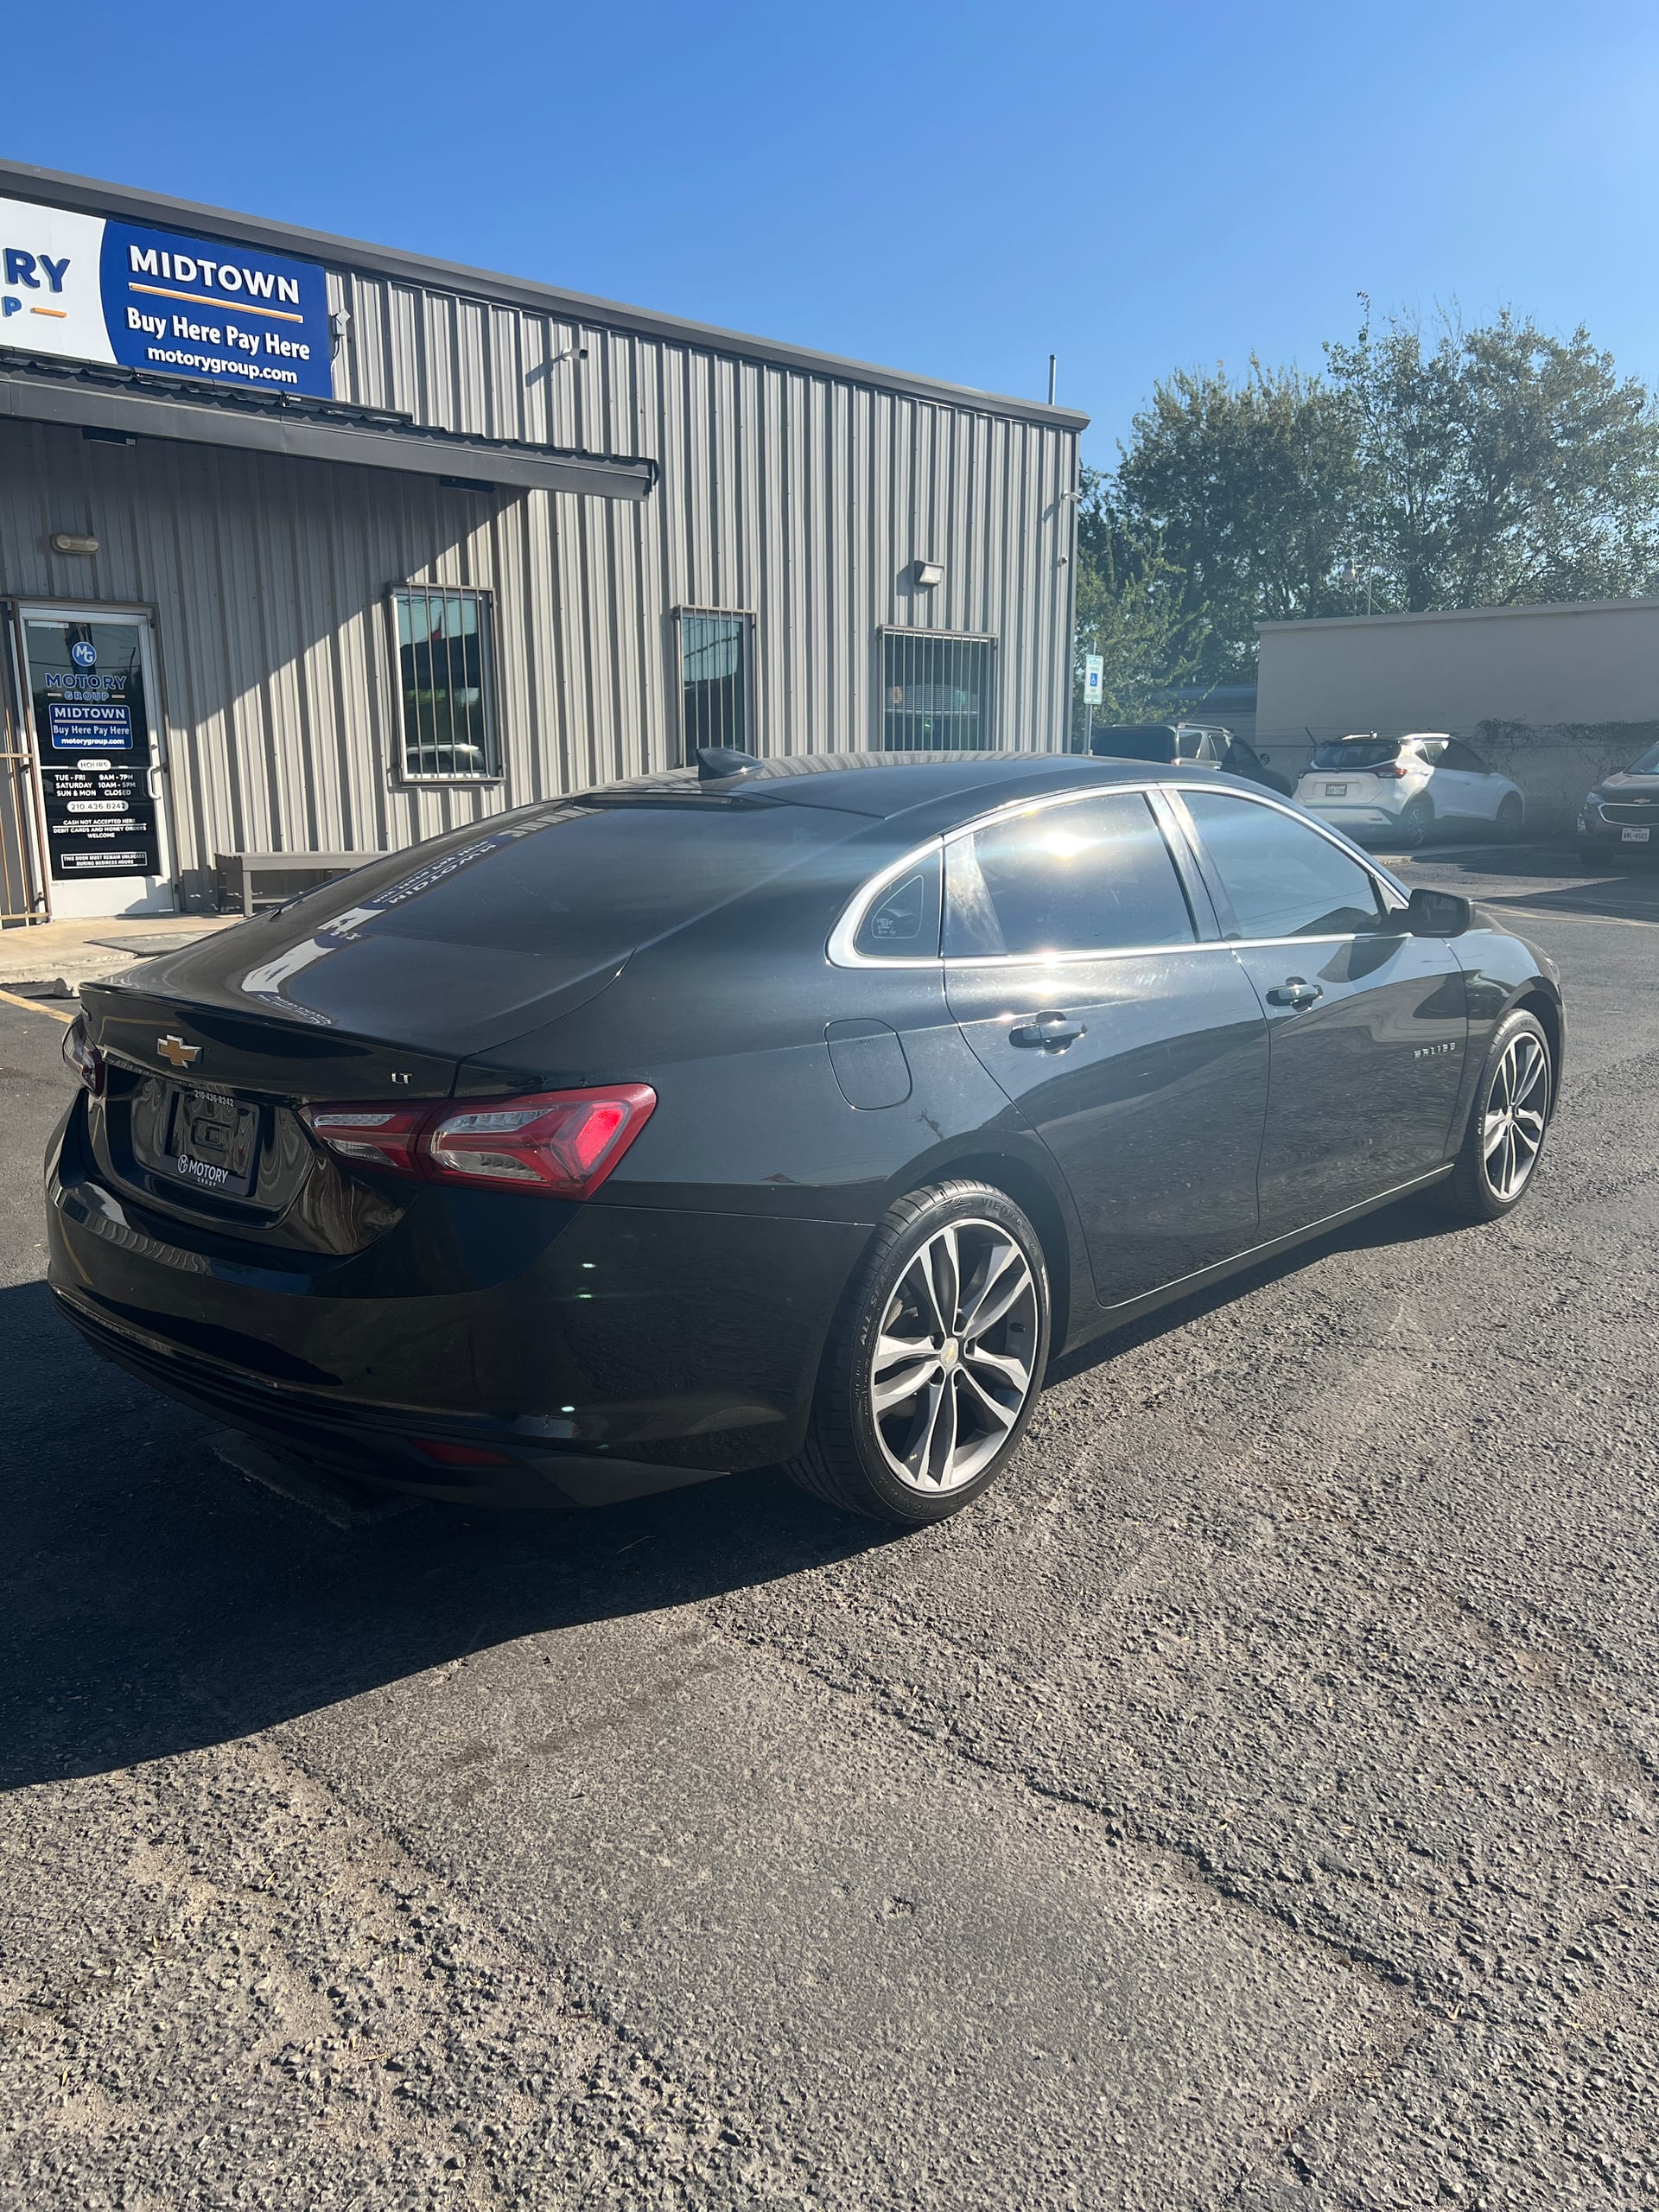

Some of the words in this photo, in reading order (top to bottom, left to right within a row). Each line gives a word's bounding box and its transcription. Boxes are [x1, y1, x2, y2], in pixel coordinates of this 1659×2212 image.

[128, 244, 301, 304] MIDTOWN
[126, 306, 167, 340] Buy
[172, 315, 220, 345] Here
[226, 325, 260, 356] Pay
[265, 332, 311, 360] Here
[147, 346, 299, 384] motorygroup.com
[45, 673, 127, 690] MOTORY
[64, 691, 110, 701] GROUP
[54, 707, 125, 719] MIDTOWN
[53, 725, 69, 735] Buy
[71, 726, 92, 734] Here
[93, 726, 108, 736] Pay
[110, 726, 130, 734] Here
[391, 1071, 413, 1084] LT
[194, 1090, 234, 1107] 210-436-8242
[188, 1160, 229, 1184] MOTORY
[197, 1177, 216, 1186] GROUP
